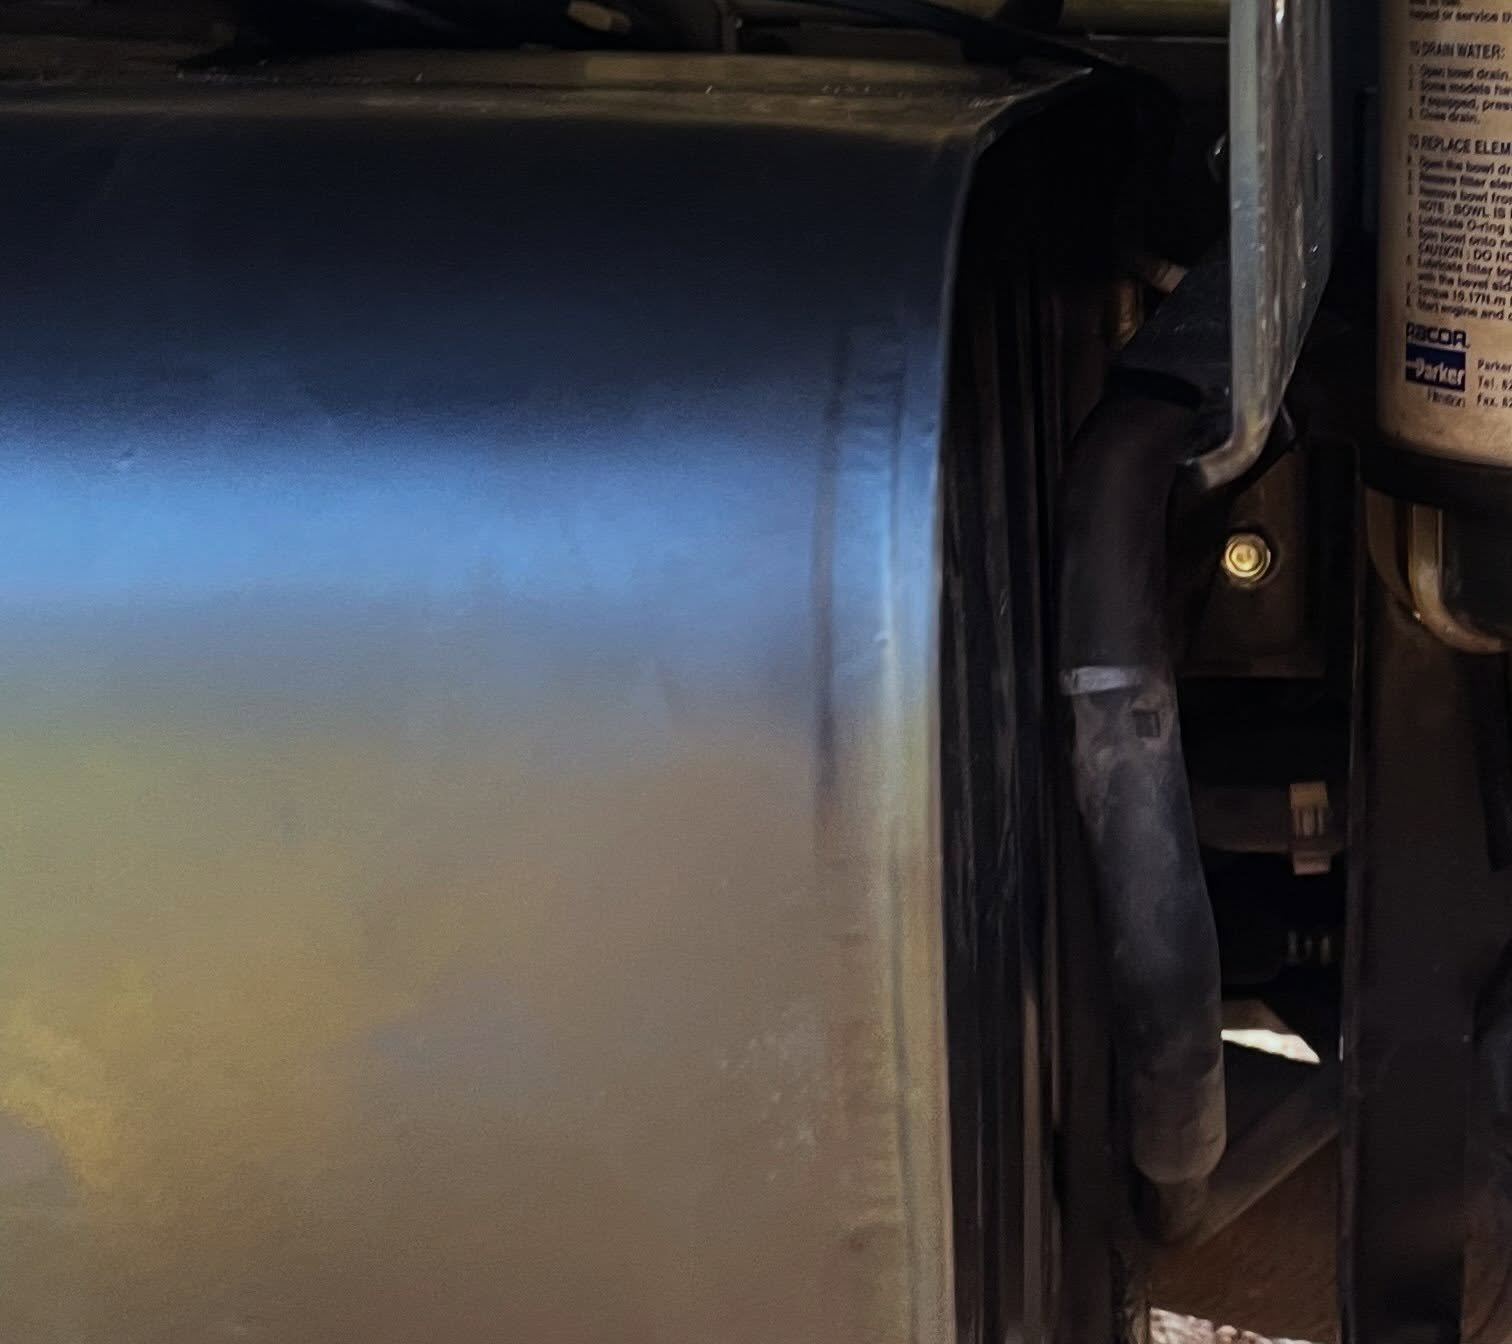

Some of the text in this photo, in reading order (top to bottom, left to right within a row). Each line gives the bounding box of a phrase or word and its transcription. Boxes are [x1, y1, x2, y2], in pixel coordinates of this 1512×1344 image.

[1493, 207, 1507, 220] IS
[1466, 218, 1506, 236] O-ring
[1469, 234, 1498, 248] onto
[1473, 247, 1494, 263] DO
[1480, 307, 1506, 322] and
[1414, 356, 1467, 388] Parker
[1477, 358, 1512, 375] Parker
